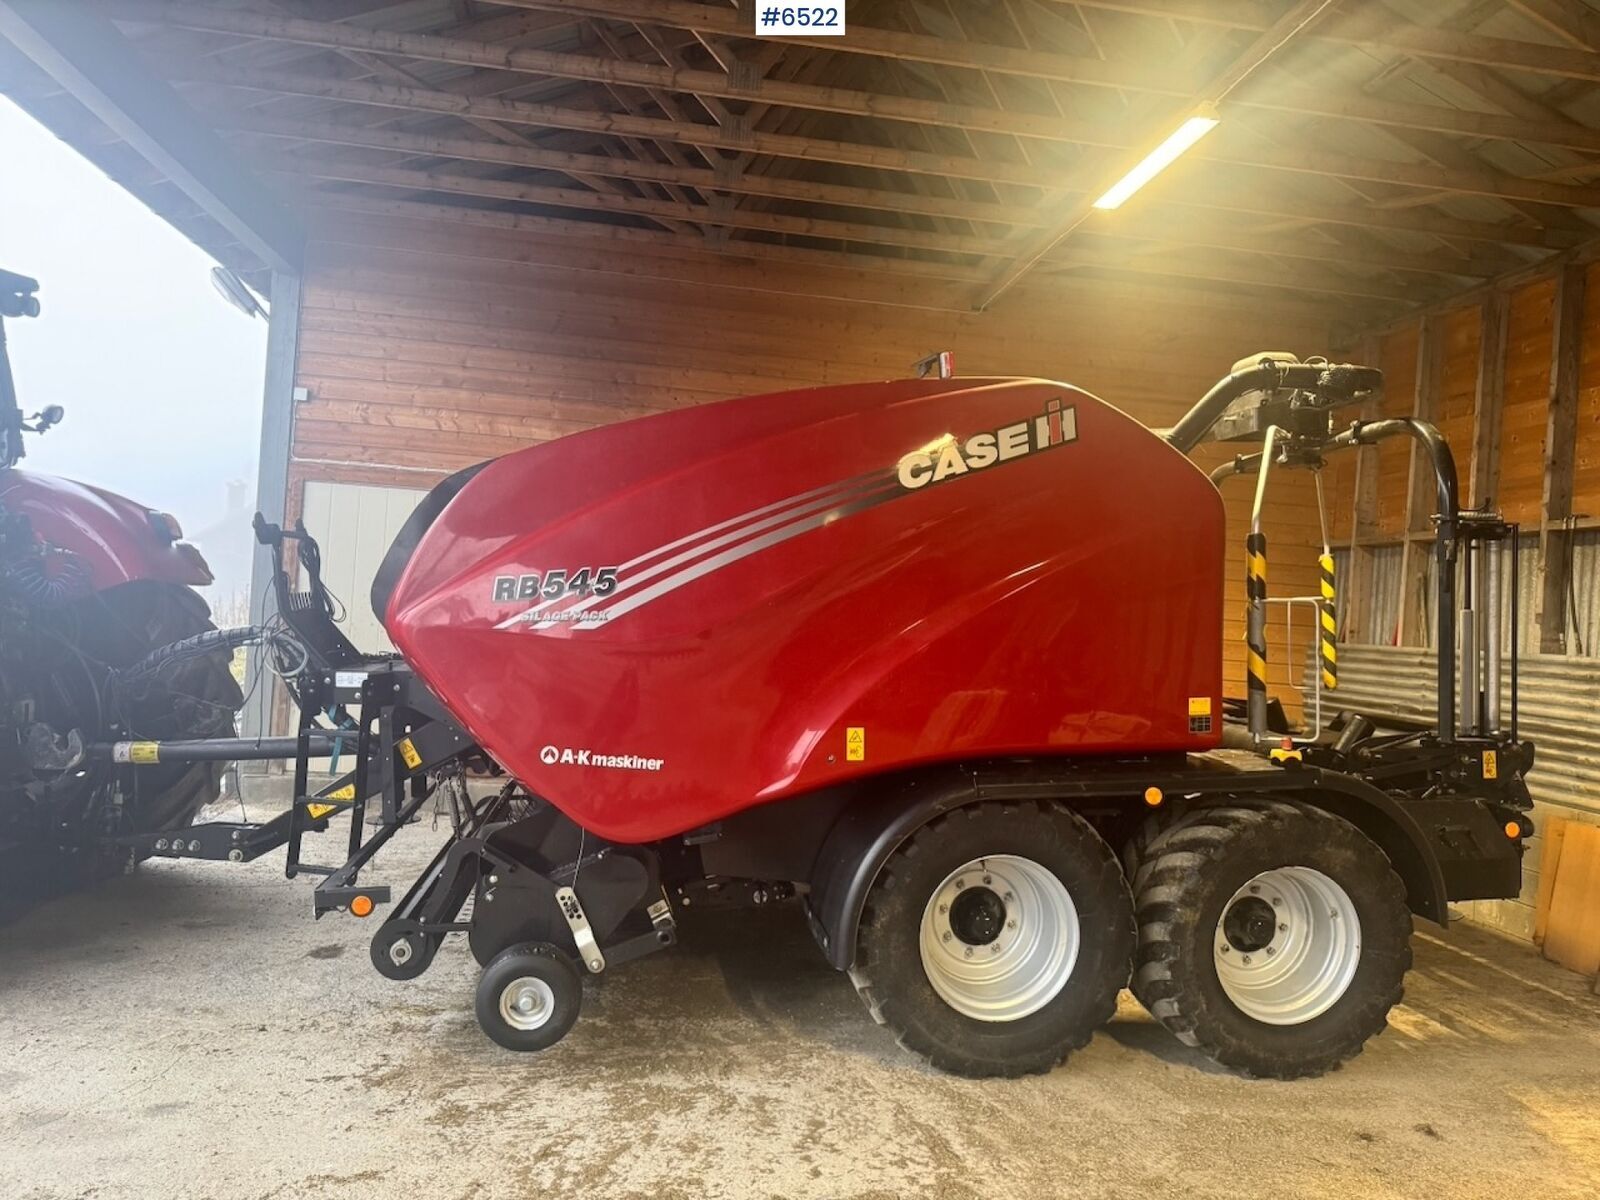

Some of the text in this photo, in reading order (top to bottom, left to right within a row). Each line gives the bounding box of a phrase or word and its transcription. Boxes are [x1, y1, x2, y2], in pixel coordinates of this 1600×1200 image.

[898, 422, 1030, 489] CASE
[571, 609, 610, 621] PACK
[591, 754, 664, 770] maskiner
